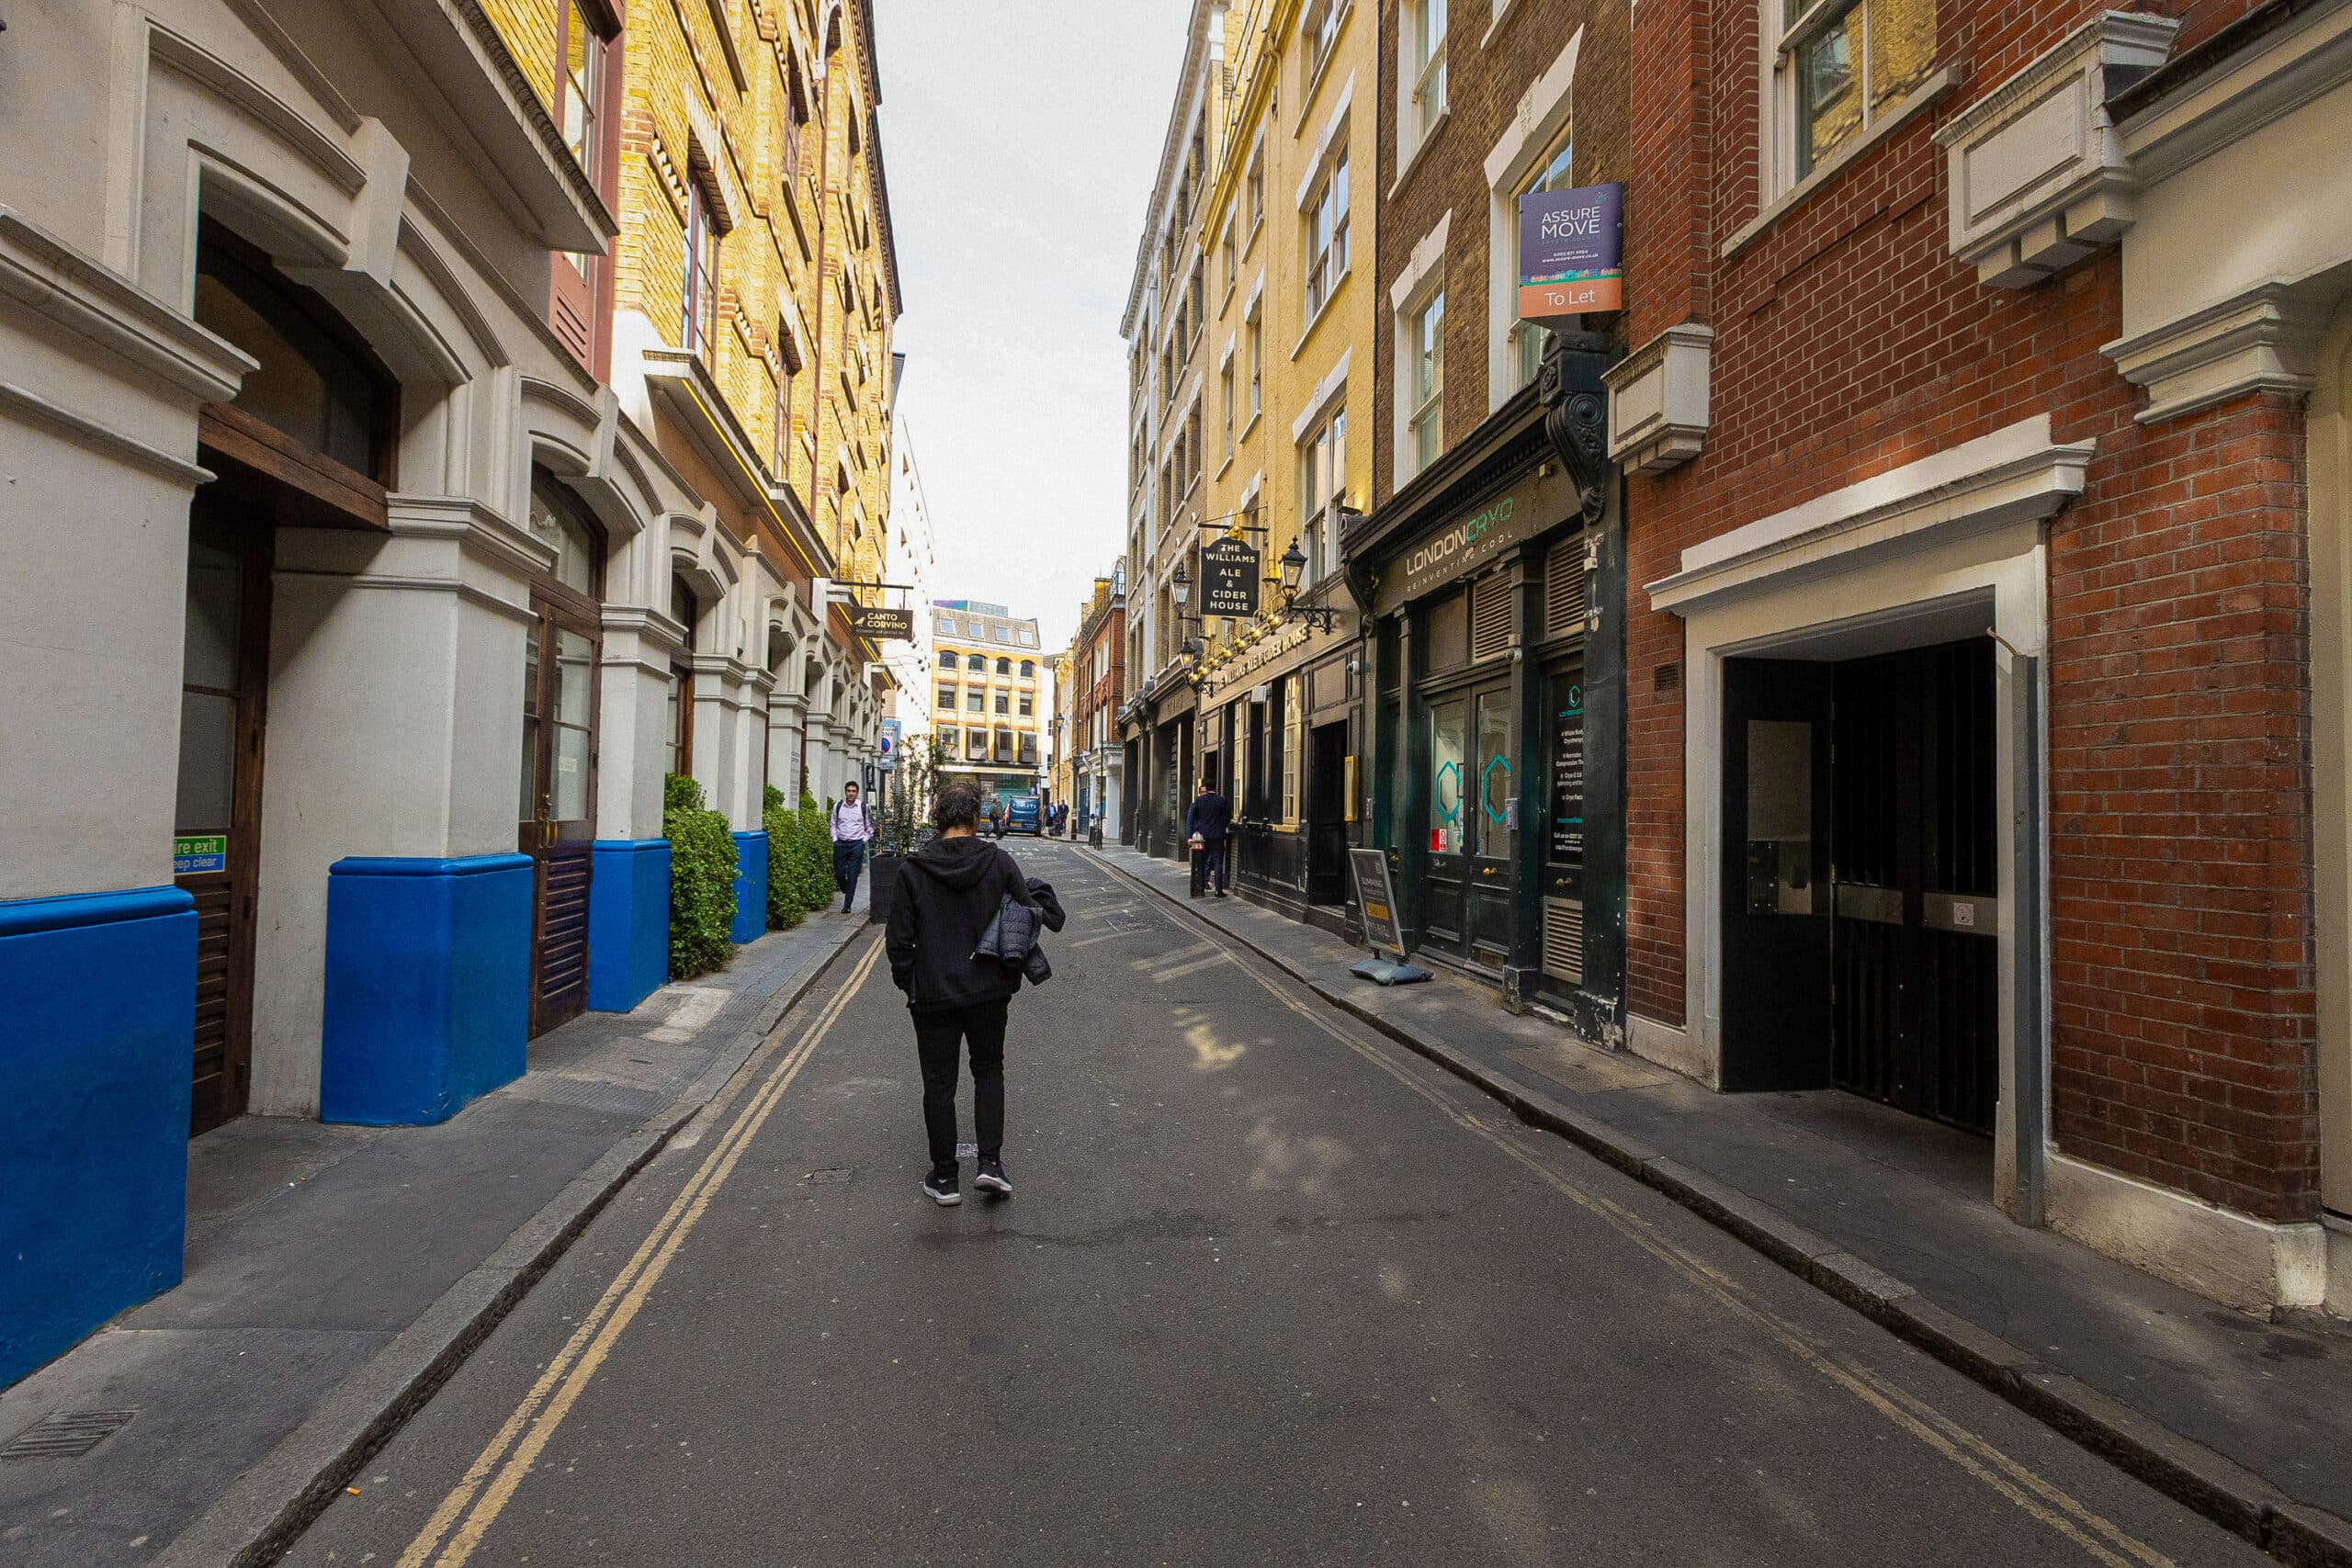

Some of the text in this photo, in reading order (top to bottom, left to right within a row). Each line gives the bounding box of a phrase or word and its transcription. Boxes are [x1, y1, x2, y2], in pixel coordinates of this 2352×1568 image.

[1542, 207, 1600, 224] ASSURE
[1542, 219, 1600, 239] MOVE
[1544, 289, 1595, 307] To Let
[1407, 497, 1514, 576] LONDONCRYO
[1481, 531, 1513, 553] COOL
[1221, 544, 1240, 552] THE
[1205, 553, 1255, 563] WILLIAMS
[1220, 569, 1241, 577] ALE
[1227, 580, 1233, 588] &
[1212, 590, 1247, 600] CIDER
[1210, 601, 1248, 611] HOUSE
[867, 613, 898, 621] CANTO
[867, 621, 907, 629] CORVINO
[1283, 624, 1307, 651] HOUSE
[174, 839, 218, 854] ire exit
[174, 857, 217, 872] eep clear
